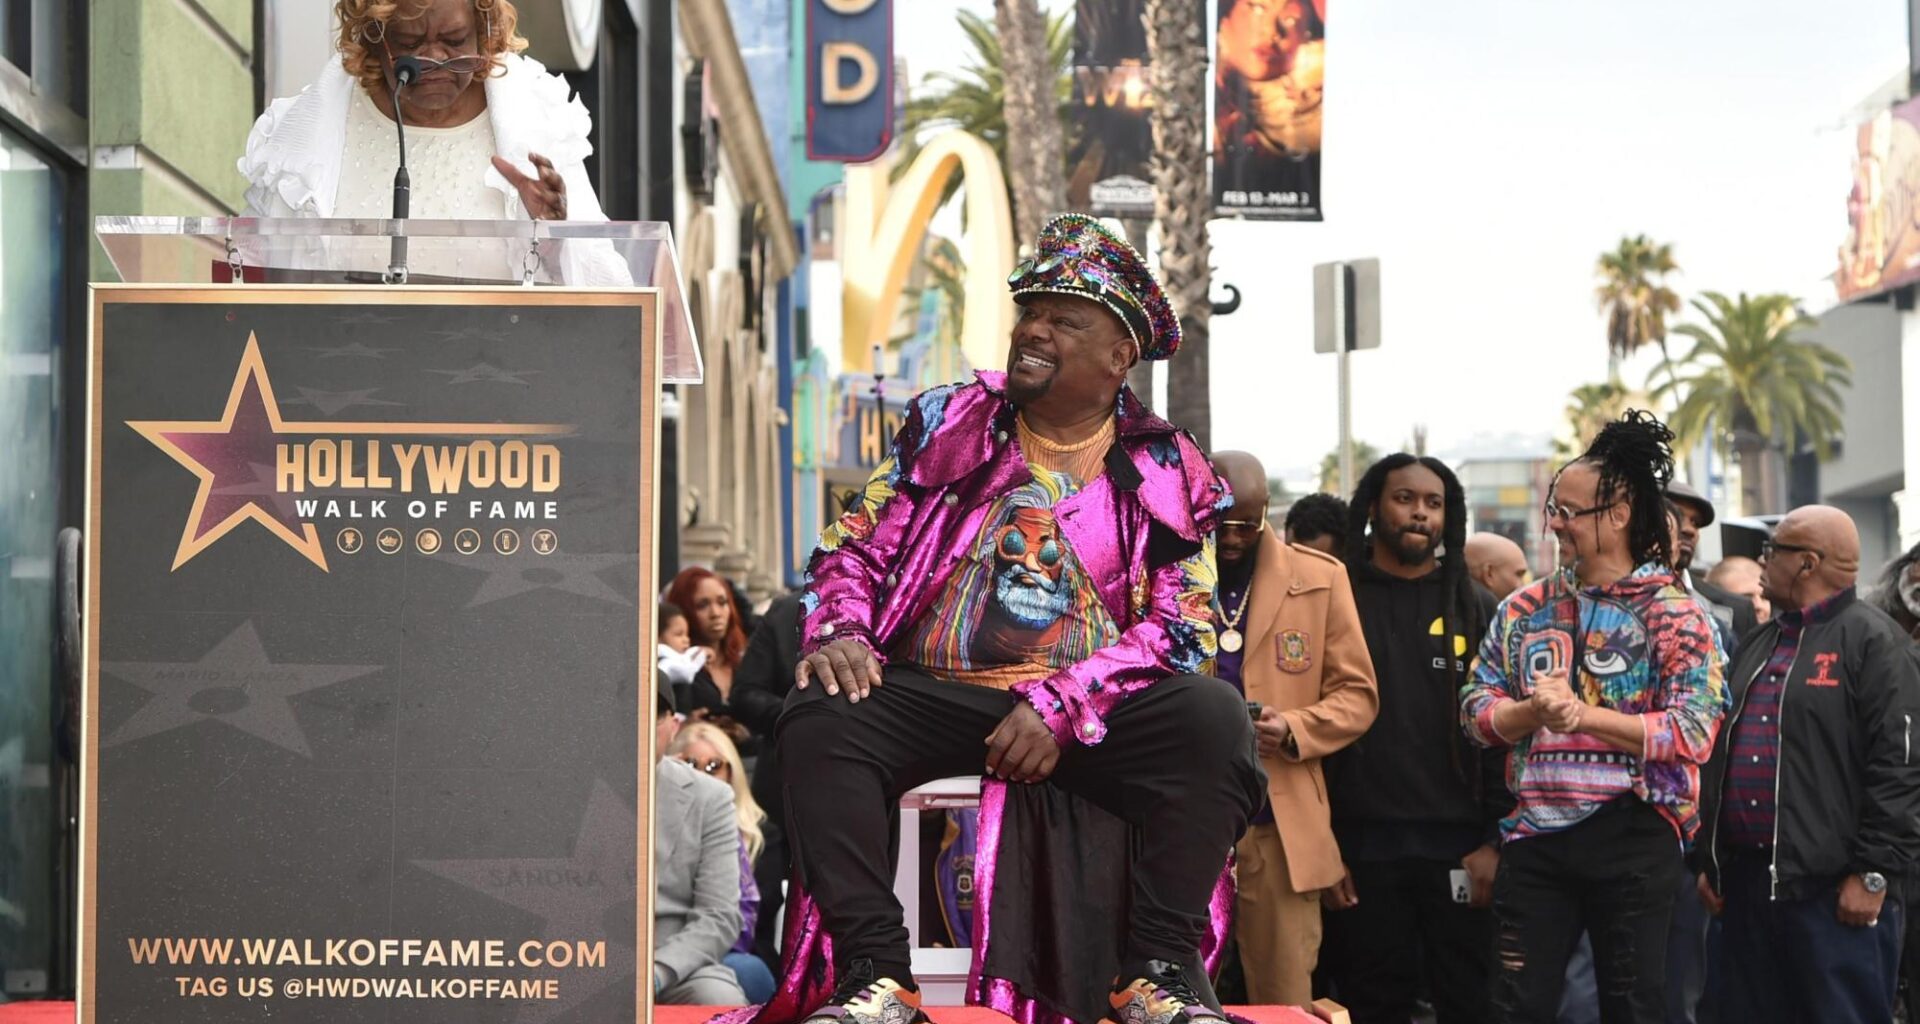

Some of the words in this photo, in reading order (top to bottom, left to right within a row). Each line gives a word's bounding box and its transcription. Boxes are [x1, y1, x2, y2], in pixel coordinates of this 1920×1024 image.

[276, 439, 560, 494] HOLLYWOOD
[295, 500, 387, 518] WALK
[408, 500, 448, 518] OF
[469, 501, 557, 519] FAME
[128, 938, 606, 968] WWW.WALKOFFAME.COM
[175, 977, 228, 997] TAG
[238, 977, 274, 998] US
[283, 978, 558, 999] @HWDWALKOFFAME
